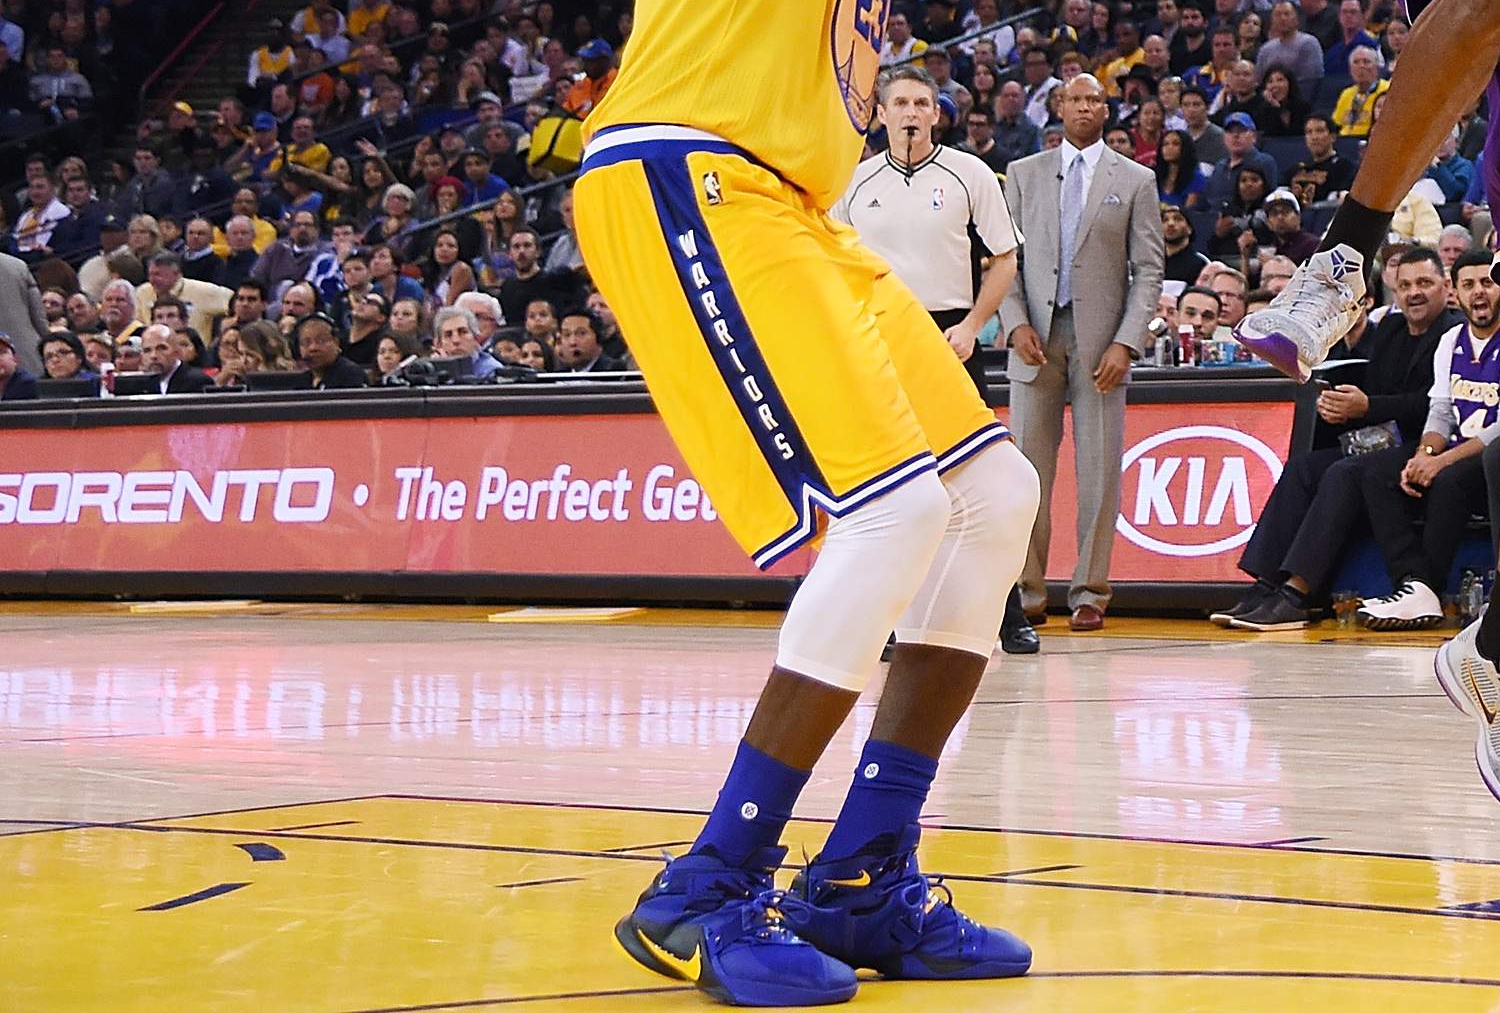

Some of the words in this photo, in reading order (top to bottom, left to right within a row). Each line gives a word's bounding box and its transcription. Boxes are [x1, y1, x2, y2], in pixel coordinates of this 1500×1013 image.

[679, 229, 794, 460] WARRIORS
[394, 466, 467, 521] The
[475, 464, 633, 521] Perfect
[1133, 456, 1253, 526] KIA
